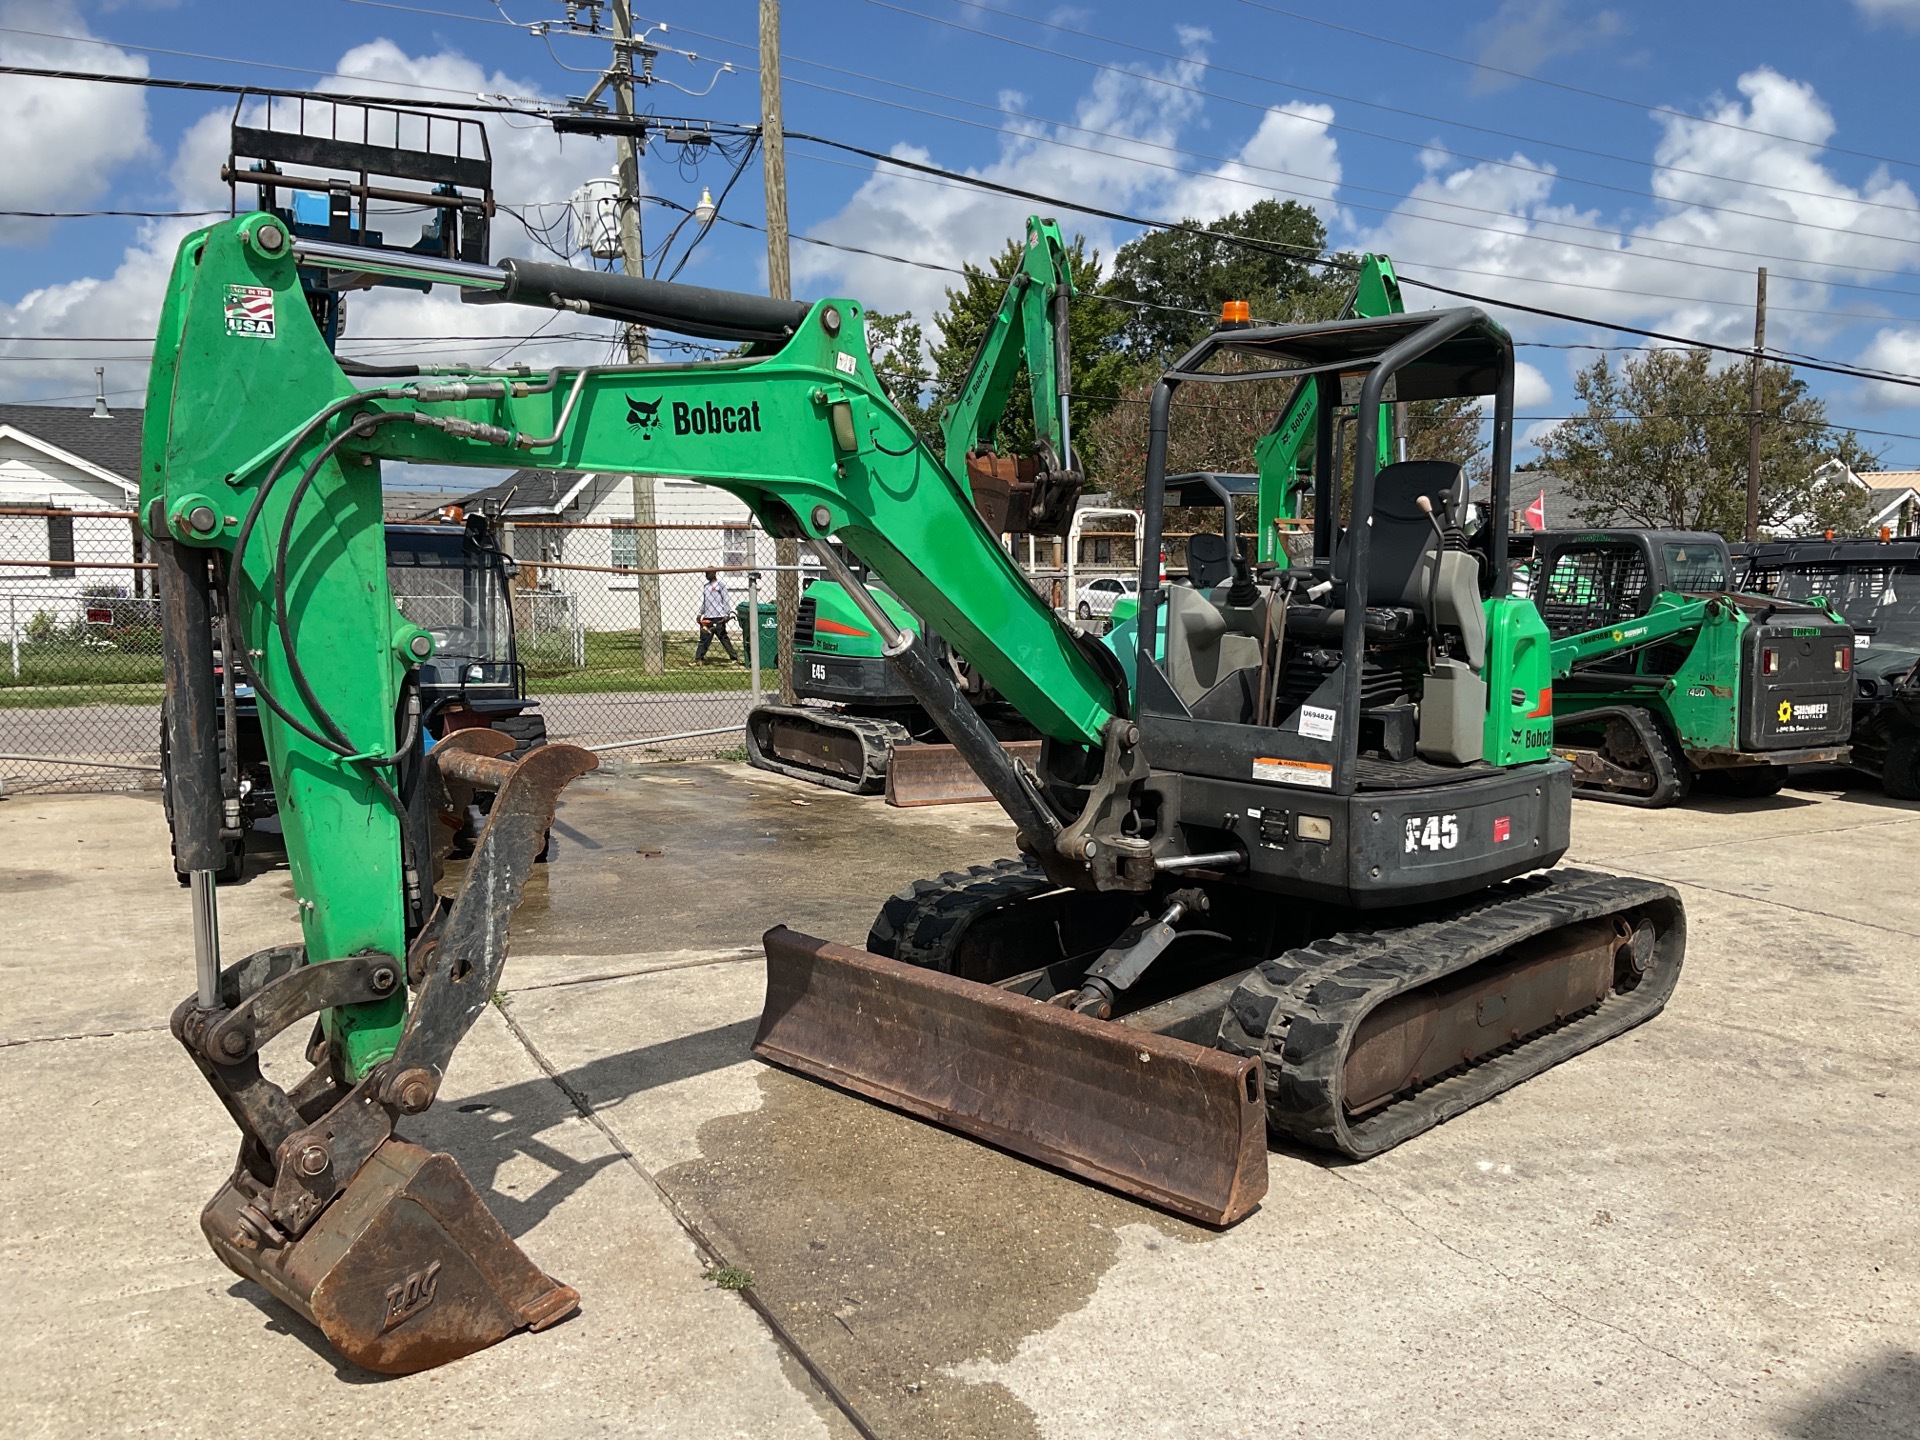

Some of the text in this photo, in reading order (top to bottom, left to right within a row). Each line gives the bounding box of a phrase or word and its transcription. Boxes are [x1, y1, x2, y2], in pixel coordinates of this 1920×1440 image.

[228, 319, 271, 333] USA
[972, 360, 989, 395] Bobcat
[672, 401, 761, 435] Bobcat
[812, 663, 826, 680] E45
[1303, 710, 1333, 721] U694824
[1793, 703, 1828, 715] SUNBELT
[1525, 728, 1552, 748] Bobca
